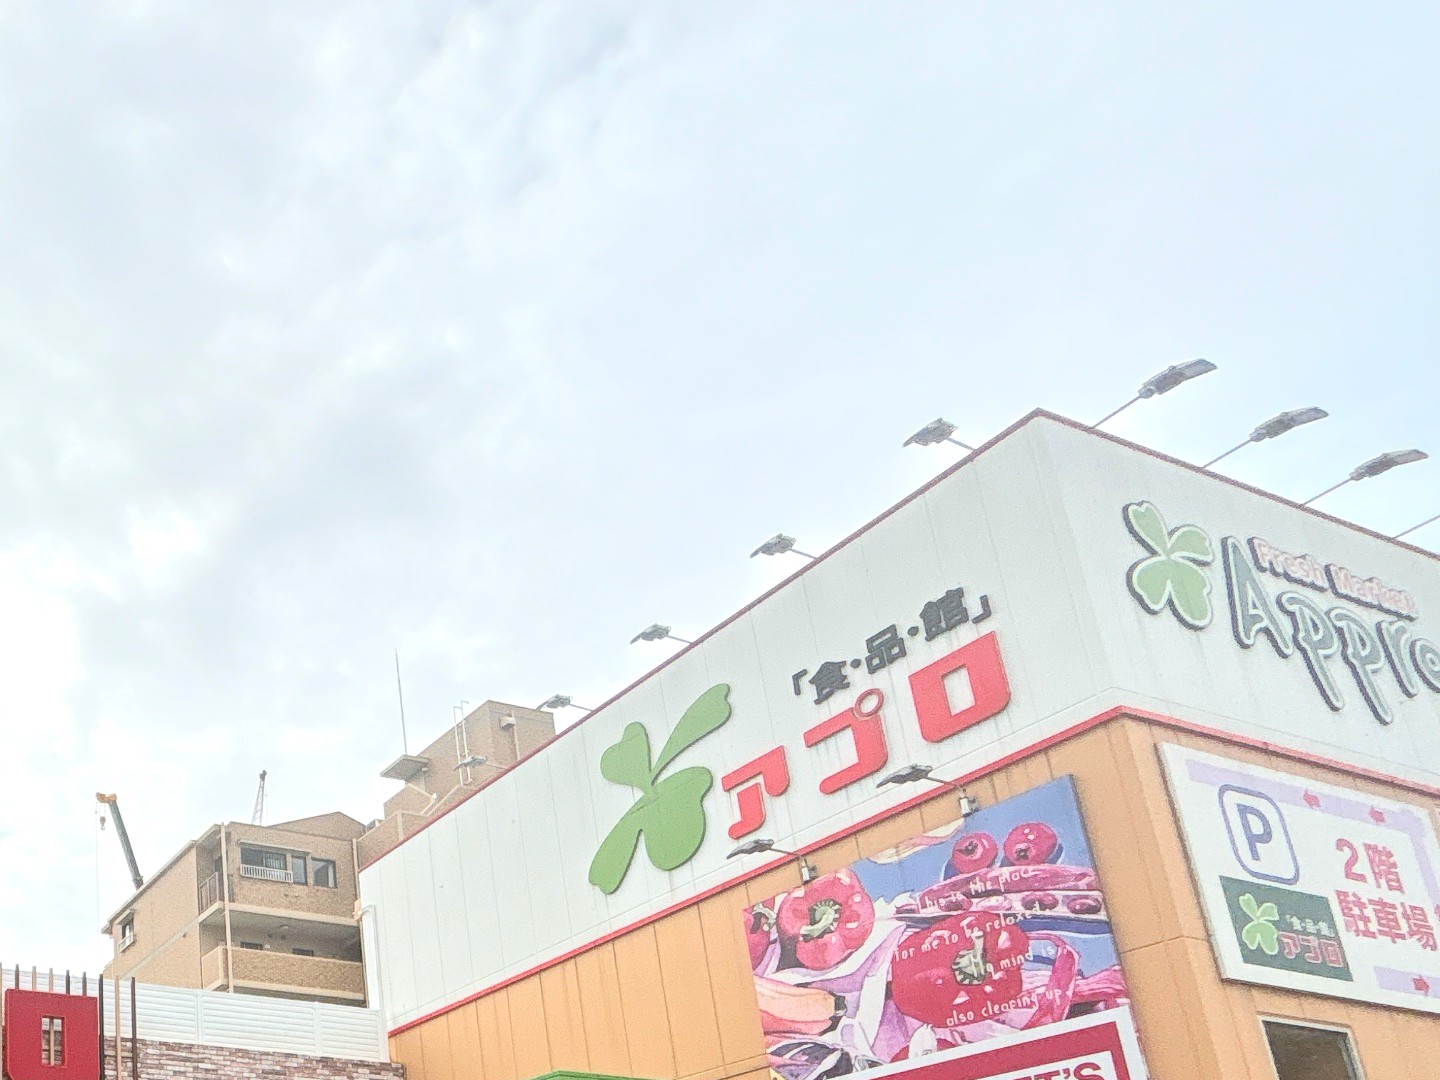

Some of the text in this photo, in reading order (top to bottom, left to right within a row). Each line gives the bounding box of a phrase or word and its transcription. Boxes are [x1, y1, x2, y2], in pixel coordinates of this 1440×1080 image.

[722, 631, 1011, 839] アプロ
[1235, 803, 1273, 861] P
[969, 877, 992, 895] the
[1336, 838, 1405, 894] 2階
[1334, 889, 1439, 951] 駐車場
[921, 940, 940, 952] me
[1000, 946, 1033, 969] mind
[946, 989, 1062, 1026] also clearing up
